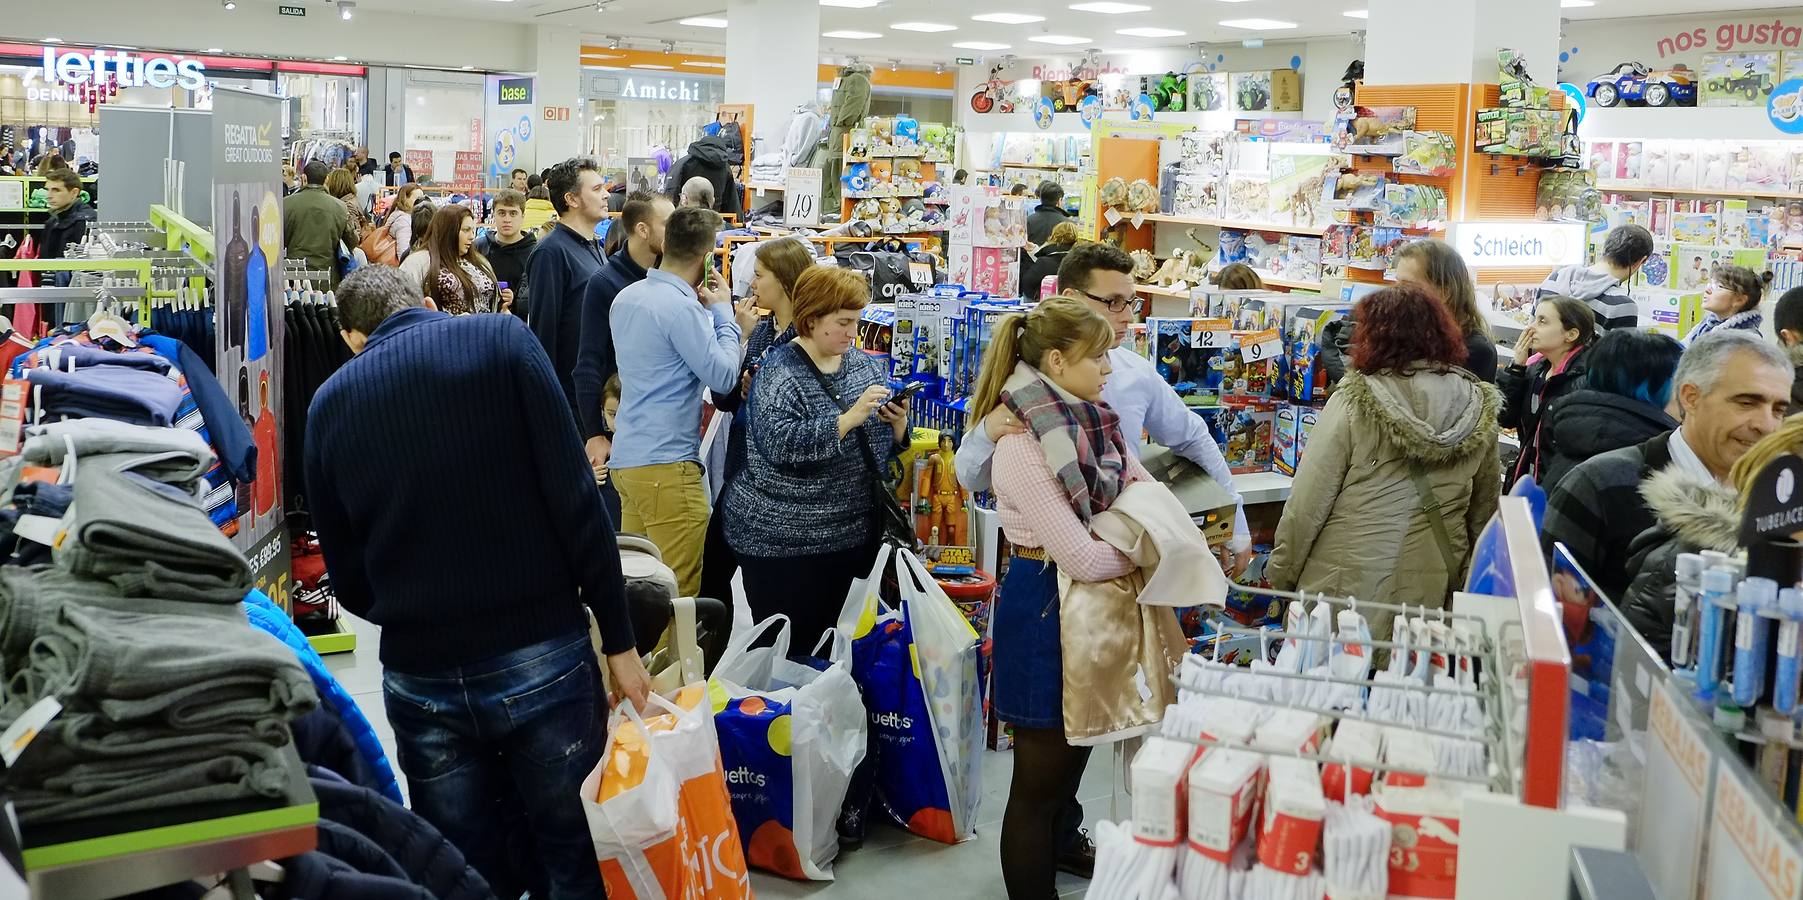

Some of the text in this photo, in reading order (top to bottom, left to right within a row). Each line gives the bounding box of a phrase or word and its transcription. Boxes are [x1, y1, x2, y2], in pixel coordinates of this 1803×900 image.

[281, 7, 304, 15] SALIDA
[1657, 20, 1802, 58] nos gusta
[501, 84, 526, 100] base
[622, 78, 699, 101] Amichi
[225, 124, 258, 146] REGATTA
[225, 147, 273, 163] GREAT OUTDOORS
[1473, 233, 1542, 256] Schleich
[917, 271, 927, 282] 21
[1196, 331, 1214, 347] 12
[1252, 343, 1262, 359] 9
[941, 554, 972, 564] WARS
[944, 548, 970, 556] STAR
